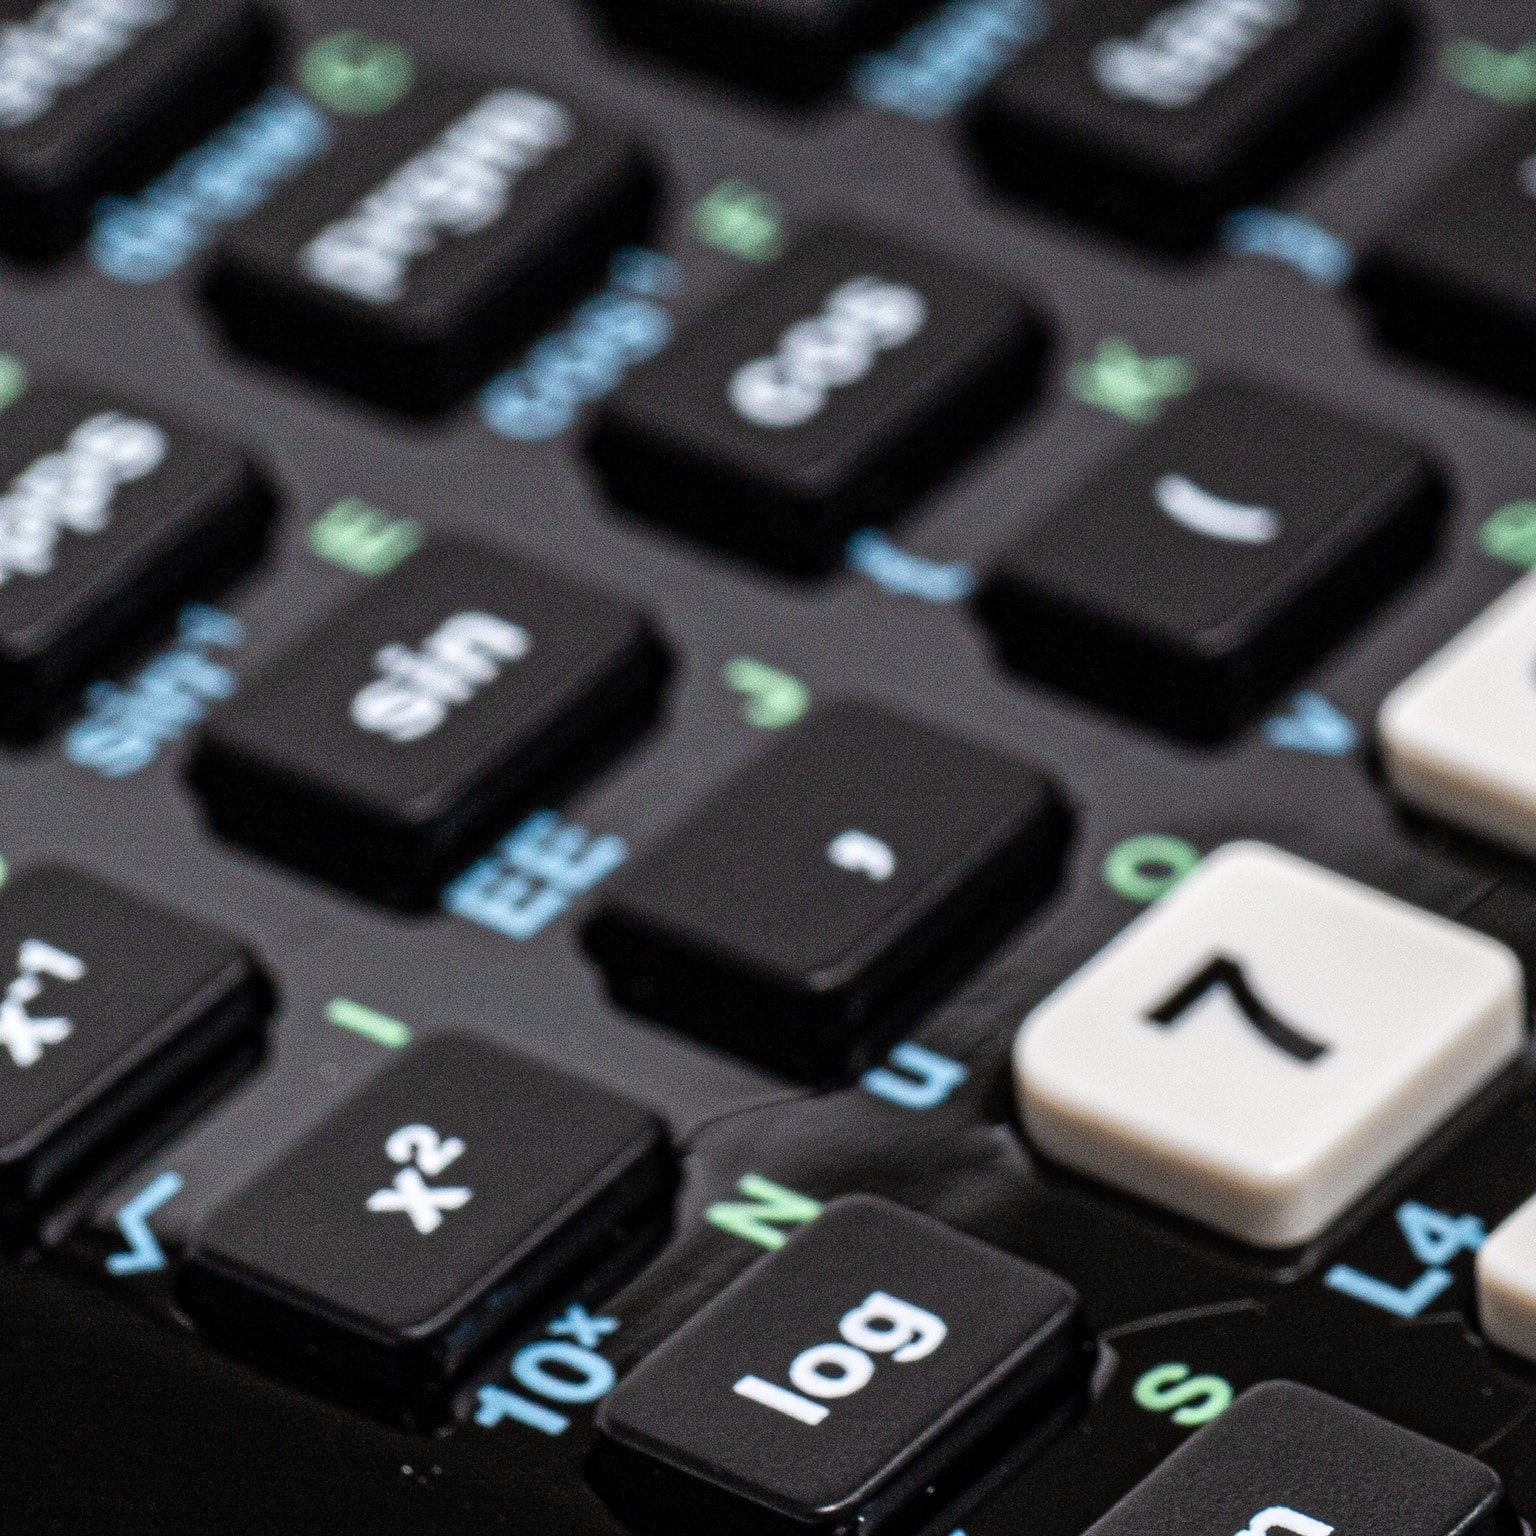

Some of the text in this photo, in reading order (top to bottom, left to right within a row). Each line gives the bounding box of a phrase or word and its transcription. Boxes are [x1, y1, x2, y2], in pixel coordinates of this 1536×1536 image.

[732, 282, 921, 424] cos
[309, 502, 419, 576] E
[353, 614, 526, 739] sin
[726, 660, 810, 730] J
[444, 810, 624, 938] EE
[1145, 953, 1328, 1065] 7
[863, 1042, 965, 1110] u
[709, 1179, 822, 1251] N
[1326, 1201, 1488, 1317] L4
[734, 1292, 947, 1425] log
[1135, 1366, 1233, 1427] S
